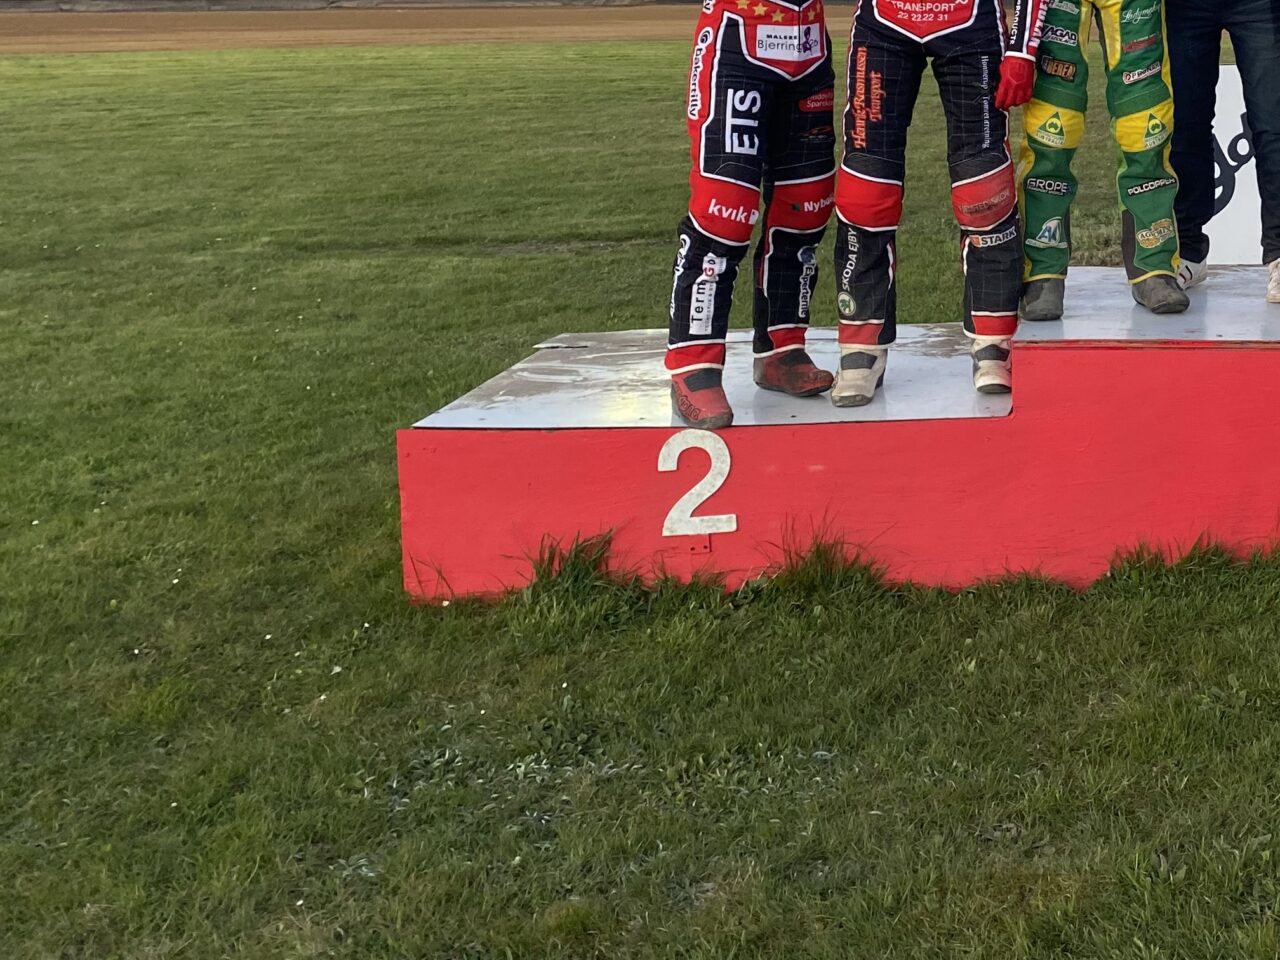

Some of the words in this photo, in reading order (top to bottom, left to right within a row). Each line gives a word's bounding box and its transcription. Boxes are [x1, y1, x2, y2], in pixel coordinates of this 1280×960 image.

[891, 1, 956, 12] TRANSPORT
[725, 88, 762, 156] ETS
[848, 228, 858, 251] EJBY
[981, 227, 1016, 246] STARK
[842, 251, 858, 292] SKODA
[657, 429, 737, 537] 2
